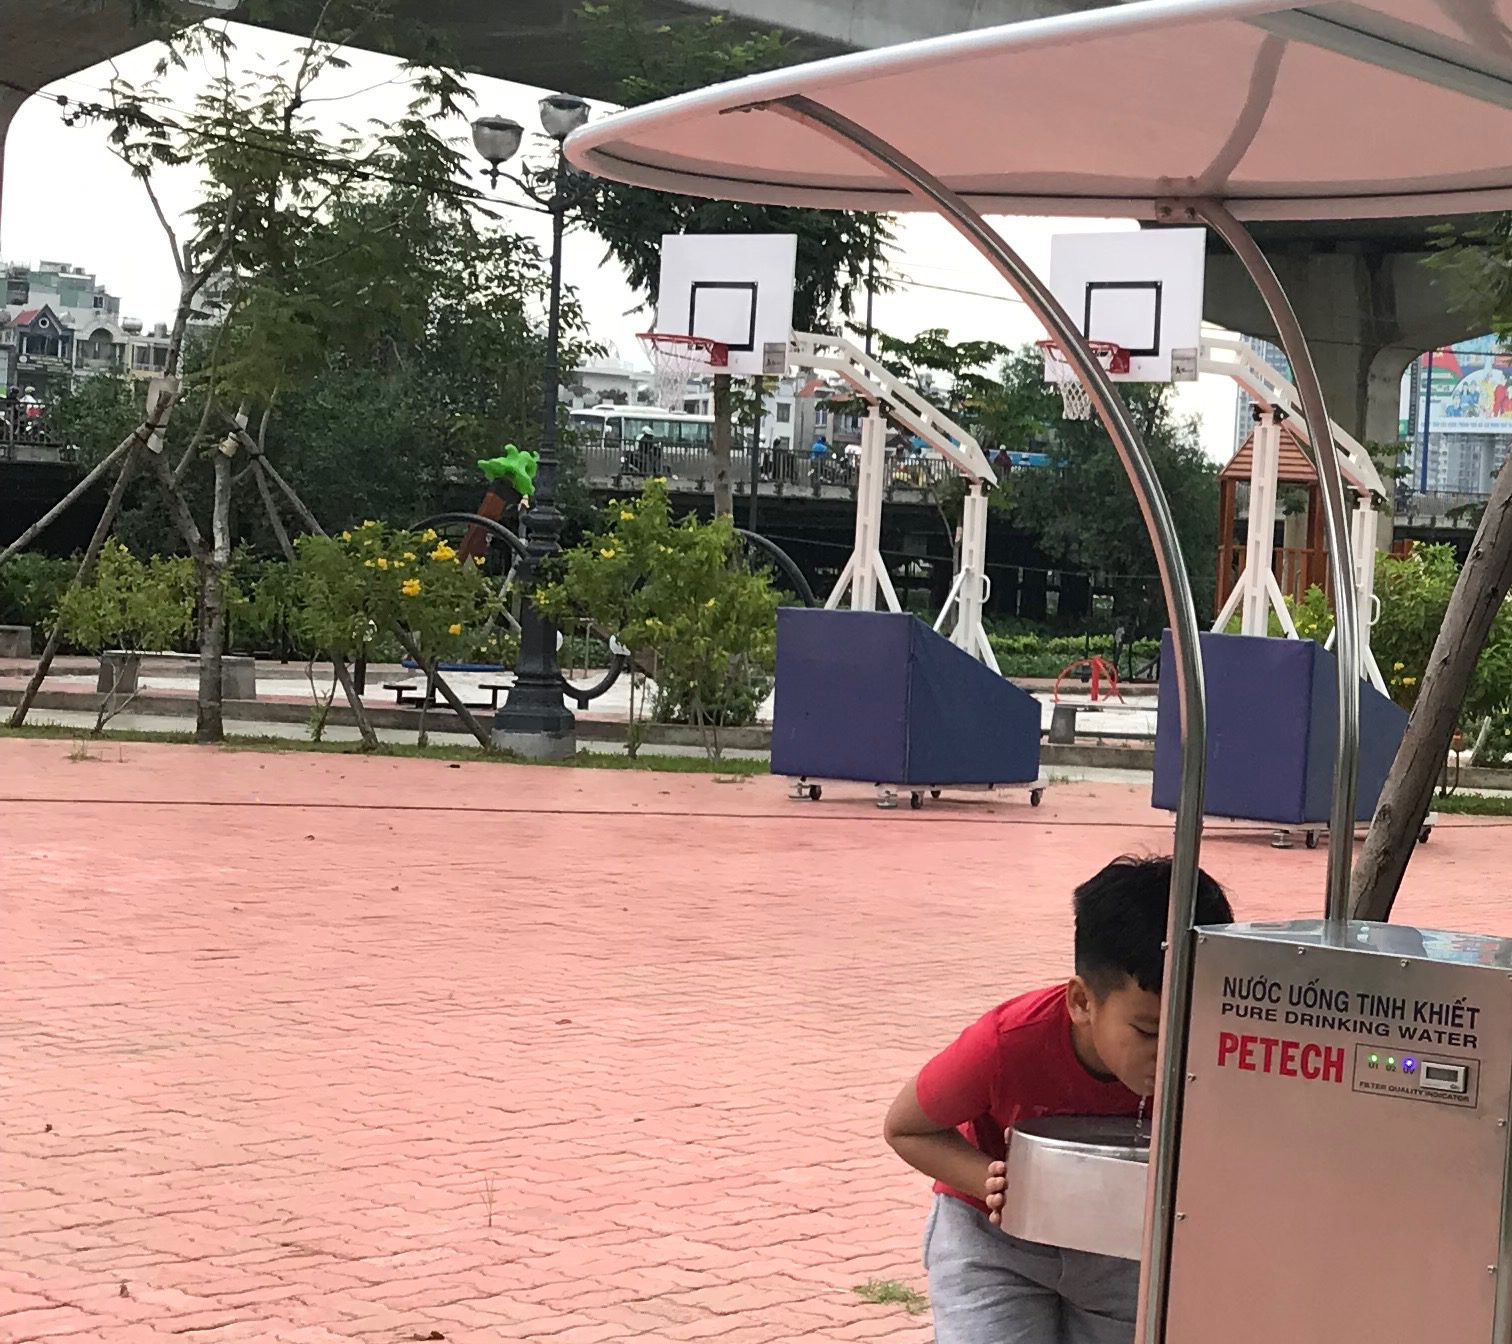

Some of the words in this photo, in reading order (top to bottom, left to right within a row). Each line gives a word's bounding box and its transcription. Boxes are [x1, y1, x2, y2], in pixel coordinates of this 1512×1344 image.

[1221, 1002, 1278, 1022] PURE
[1284, 1010, 1391, 1037] DRINKING
[1397, 1024, 1478, 1049] WATER
[1222, 975, 1282, 1004] NƯỚC
[1288, 978, 1350, 1013] UỐNG
[1356, 992, 1406, 1021] TINH
[1413, 996, 1481, 1030] KHIẾT
[1217, 1031, 1345, 1083] PETECH
[1359, 1081, 1387, 1090] FILTER
[1388, 1084, 1424, 1096] QUALITY
